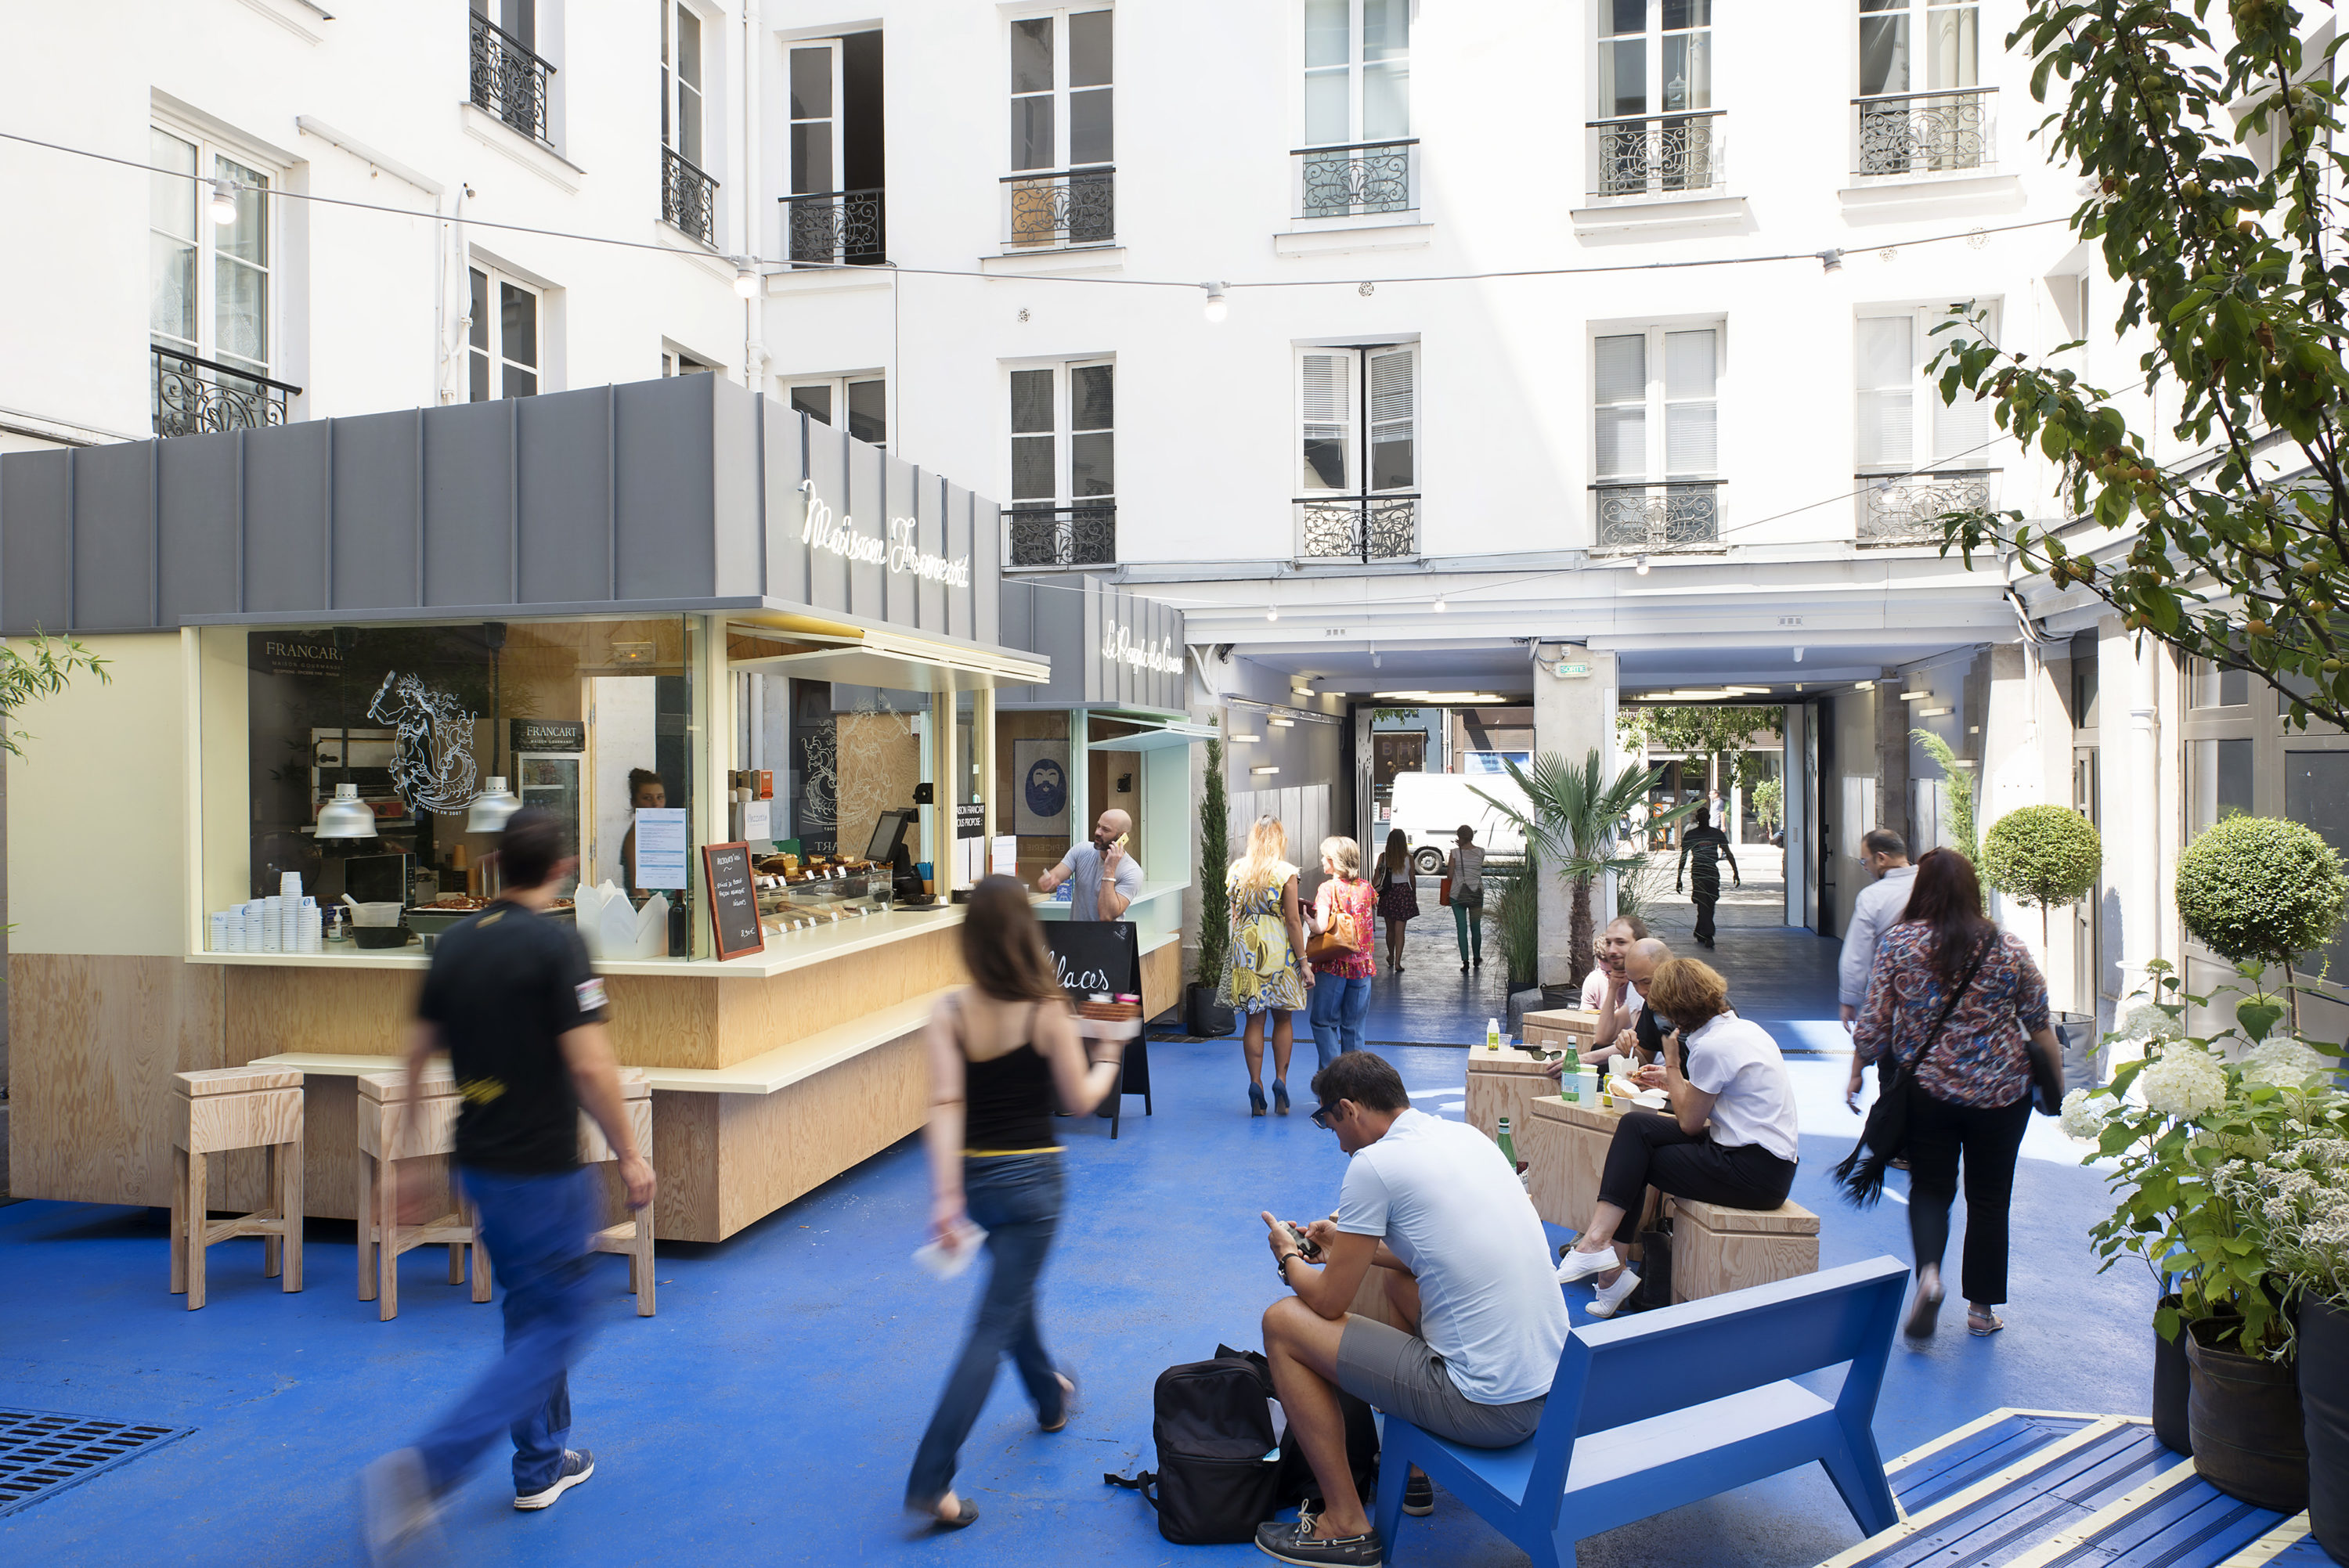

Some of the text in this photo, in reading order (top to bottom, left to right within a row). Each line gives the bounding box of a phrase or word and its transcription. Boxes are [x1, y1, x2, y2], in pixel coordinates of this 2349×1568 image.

[801, 480, 887, 564] Maison
[266, 641, 344, 661] FRANCAR
[1561, 665, 1586, 673] SORTIE
[527, 726, 576, 737] FRANCART
